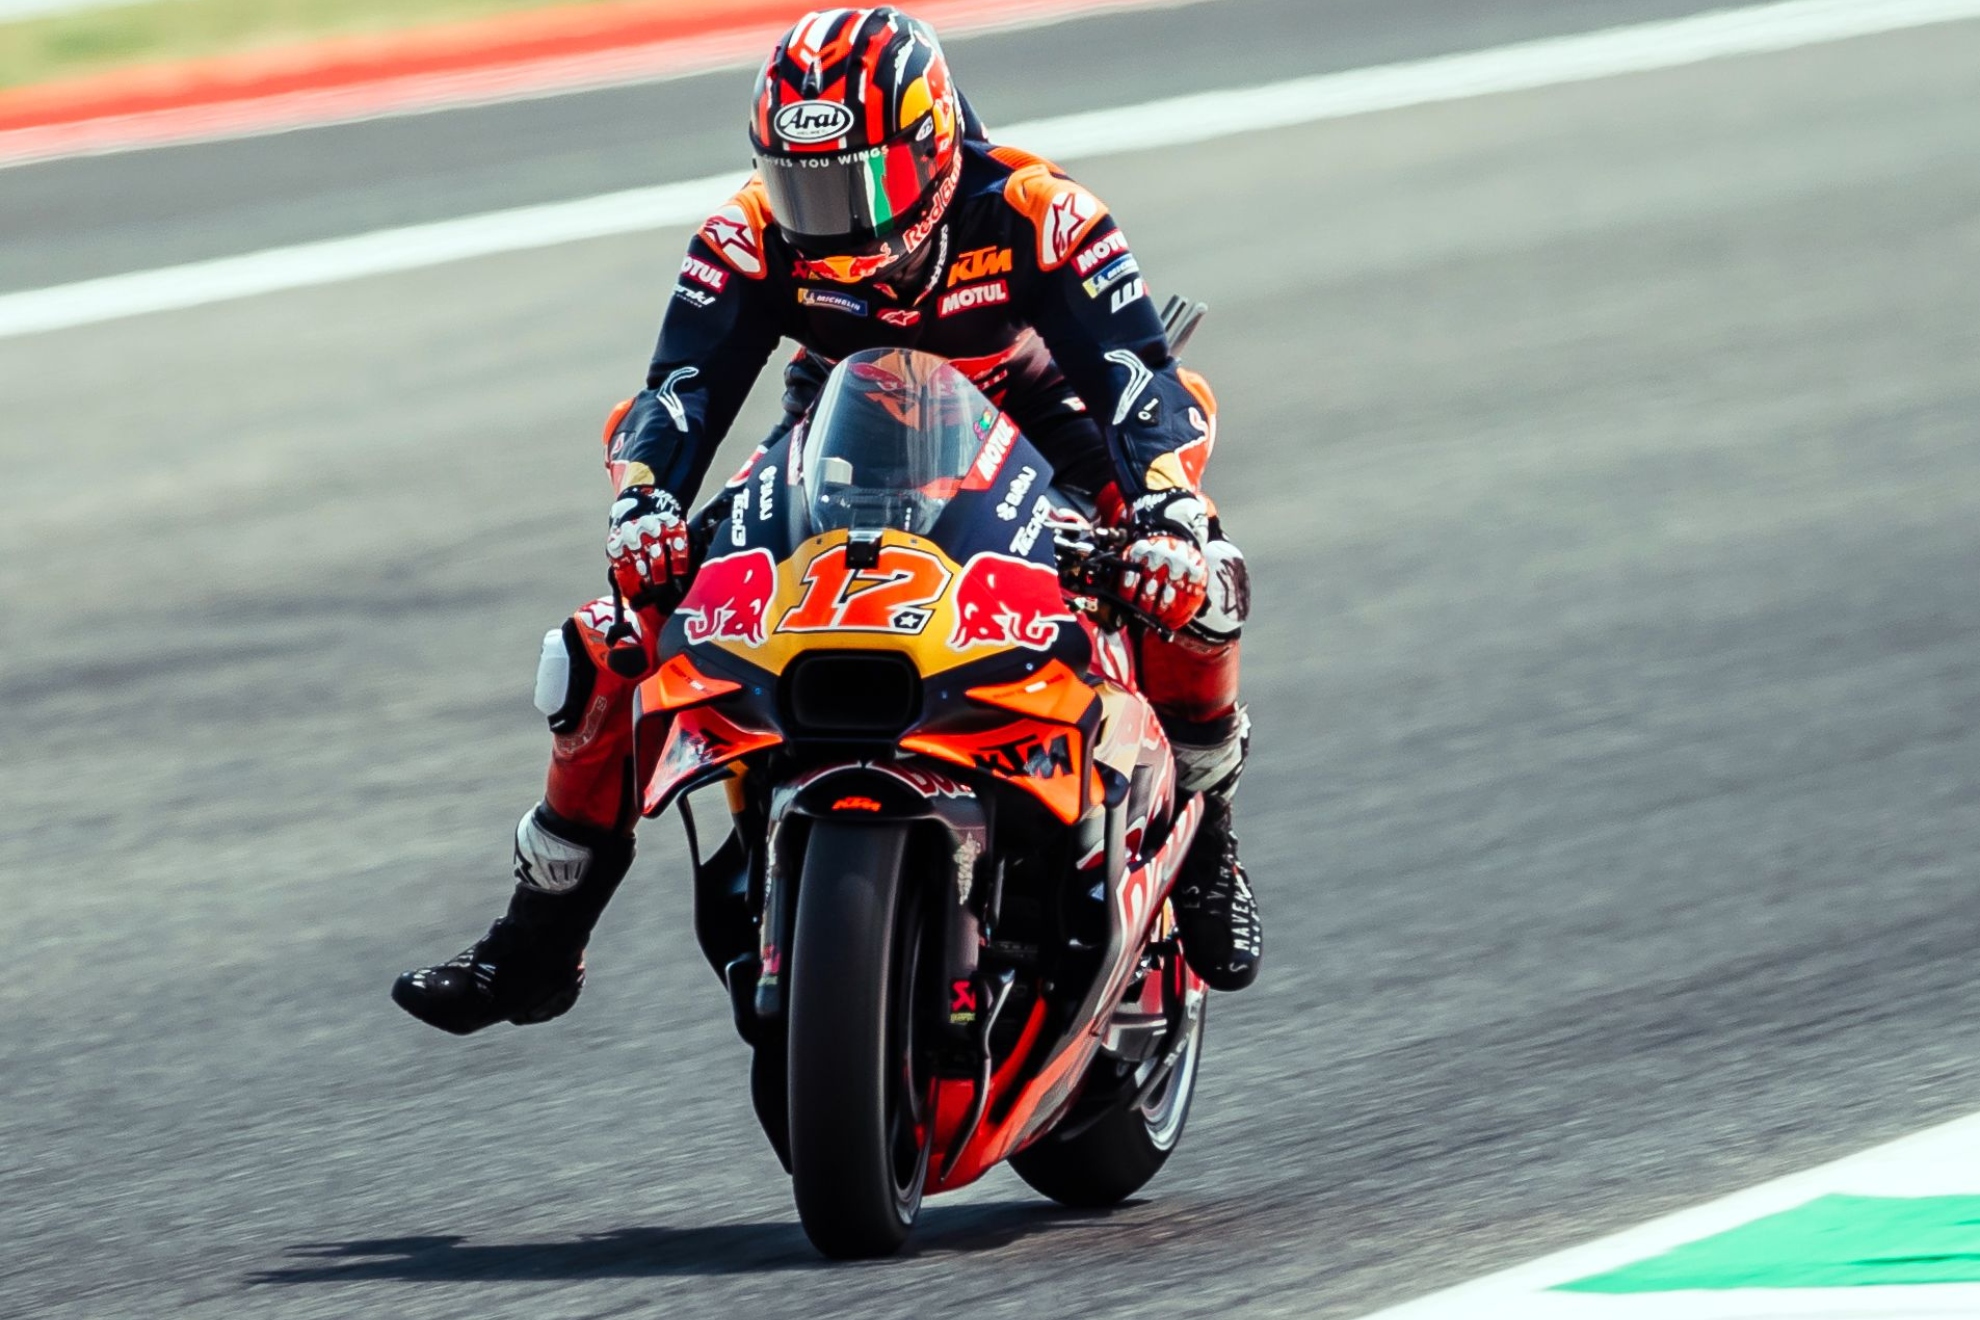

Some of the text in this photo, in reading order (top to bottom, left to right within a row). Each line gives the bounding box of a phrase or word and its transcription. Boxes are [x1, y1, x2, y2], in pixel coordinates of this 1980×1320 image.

[780, 107, 840, 129] Arai
[800, 158, 830, 168] YOU
[838, 144, 890, 165] WINGS
[681, 256, 723, 288] OTUL
[947, 245, 1012, 288] KTM
[816, 294, 861, 311] MICHELIN
[941, 283, 1006, 315] MOTUL
[976, 417, 1016, 482] MOTUL
[774, 544, 953, 634] 12
[971, 733, 1074, 779] KTM
